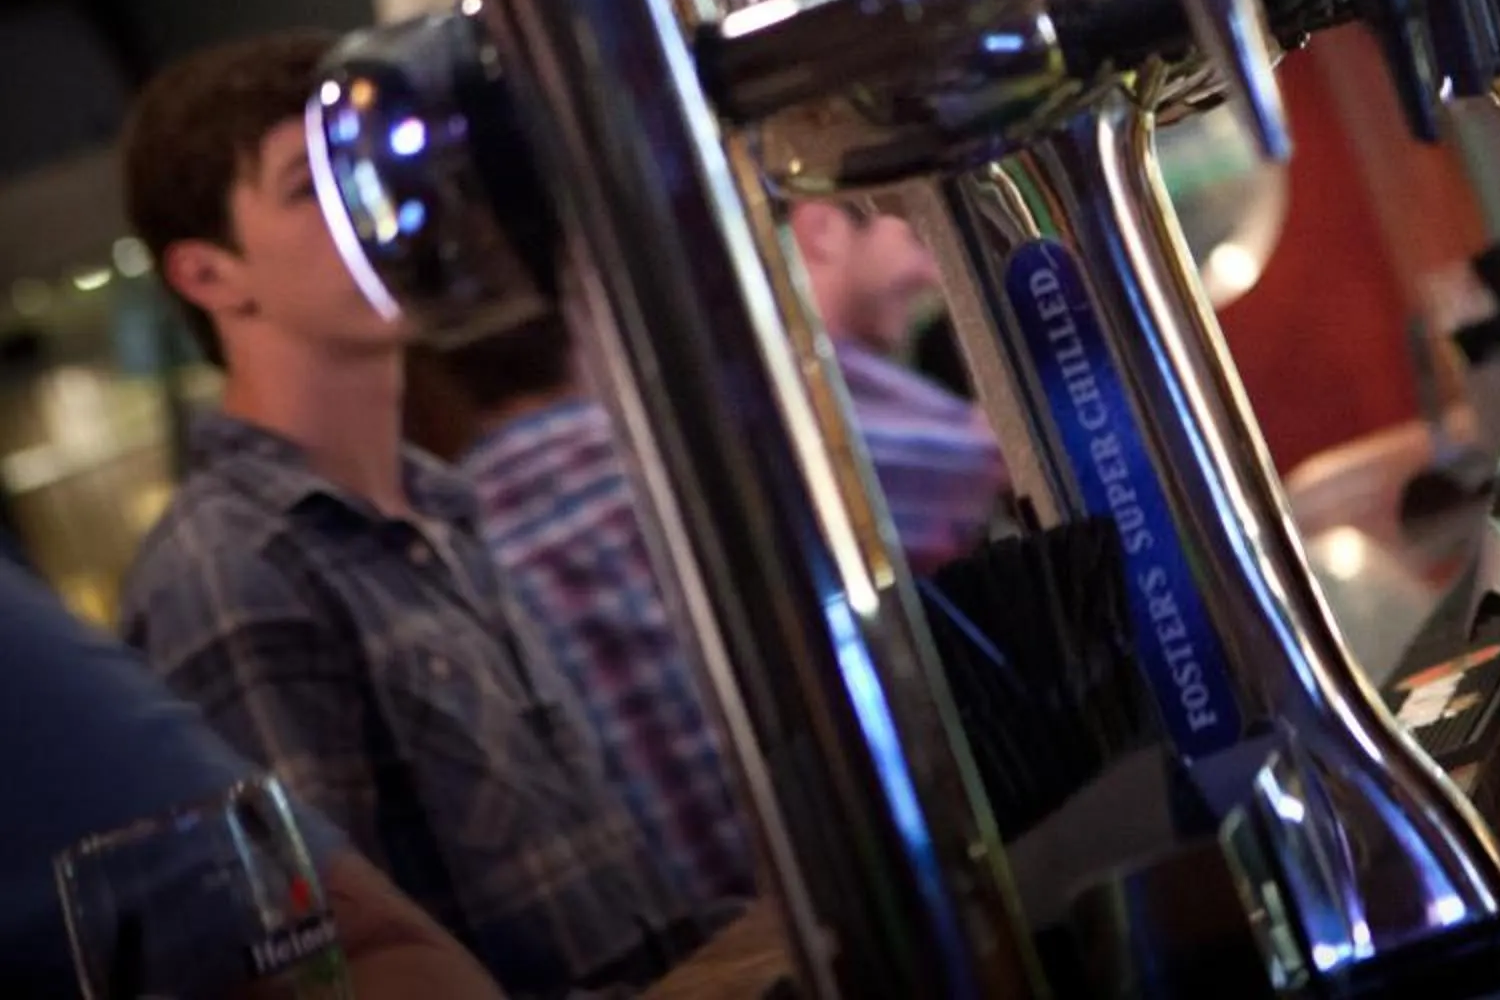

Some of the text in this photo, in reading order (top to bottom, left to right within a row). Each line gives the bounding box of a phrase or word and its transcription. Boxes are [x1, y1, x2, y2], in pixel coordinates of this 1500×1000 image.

[1029, 267, 1218, 733] FOSTER'S SUPER CHILLED
